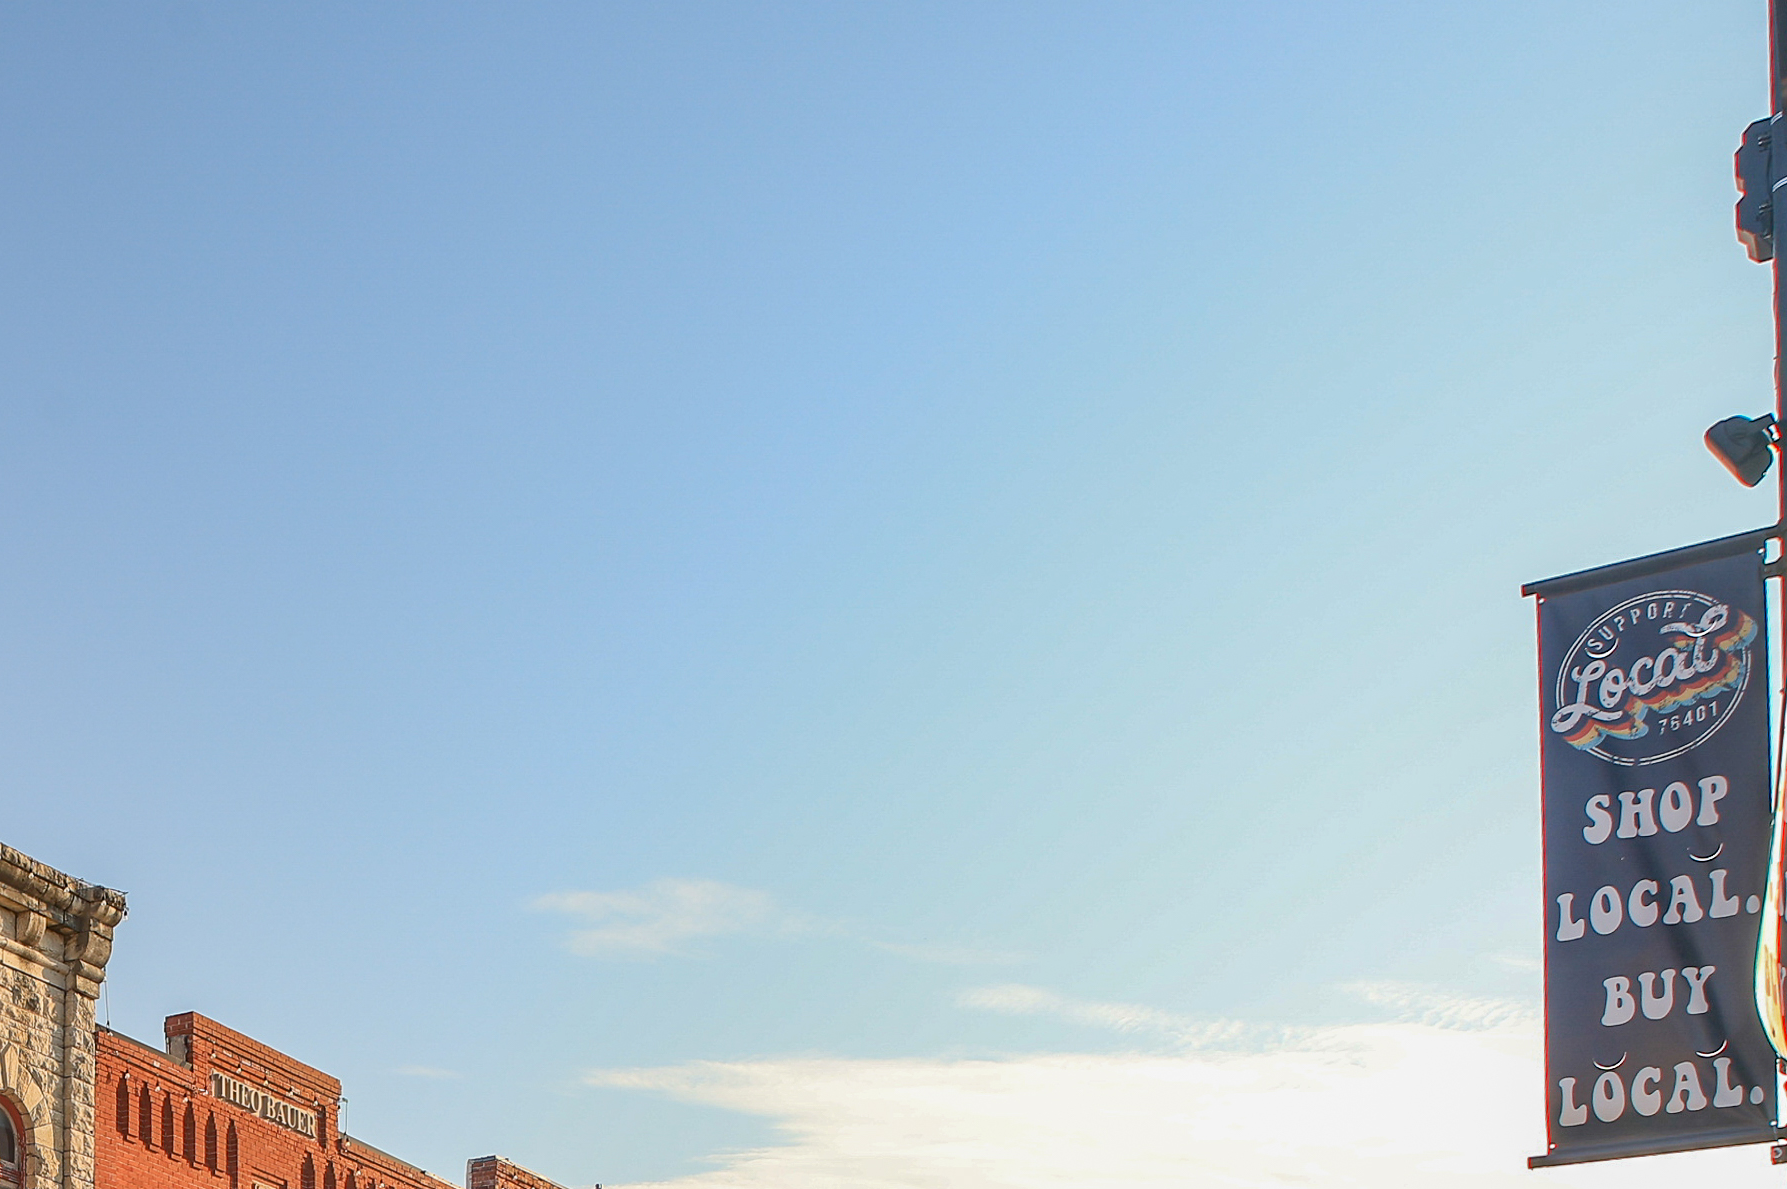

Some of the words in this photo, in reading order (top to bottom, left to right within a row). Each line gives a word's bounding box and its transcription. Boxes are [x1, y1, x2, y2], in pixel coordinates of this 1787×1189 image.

[1585, 602, 1692, 651] SUPPORT
[1551, 604, 1729, 733] Local
[1659, 701, 1719, 735] 76401
[1583, 775, 1728, 845] SHOP
[1556, 869, 1761, 942] LOCAL.
[1600, 965, 1716, 1027] BUY
[218, 1073, 262, 1114] THEO
[266, 1096, 317, 1138] BAUER
[1558, 1057, 1764, 1127] LOCAL.
